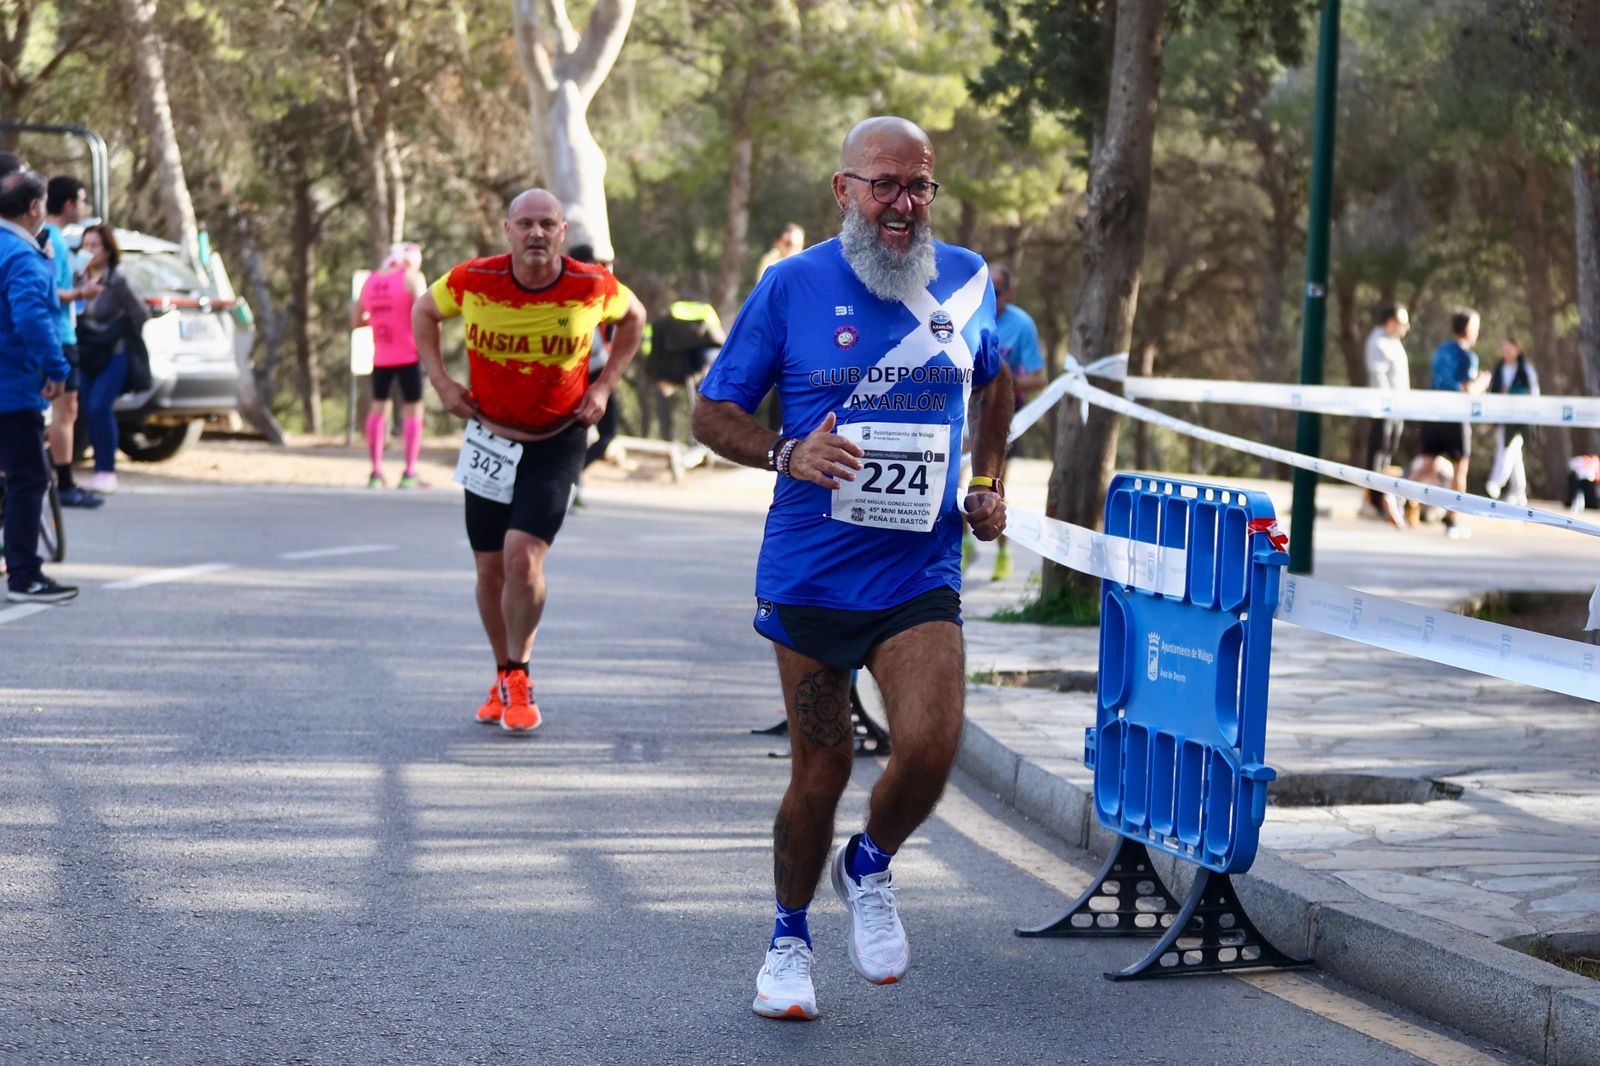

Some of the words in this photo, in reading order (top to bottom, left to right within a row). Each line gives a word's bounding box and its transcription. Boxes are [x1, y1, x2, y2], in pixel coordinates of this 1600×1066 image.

[809, 367, 862, 388] CLUB
[850, 391, 947, 411] AXARLÓN
[469, 450, 502, 481] 342
[861, 462, 929, 495] 224
[900, 518, 928, 526] BASTÓN
[1161, 640, 1190, 656] Ayuntamiento
[1190, 648, 1197, 659] de
